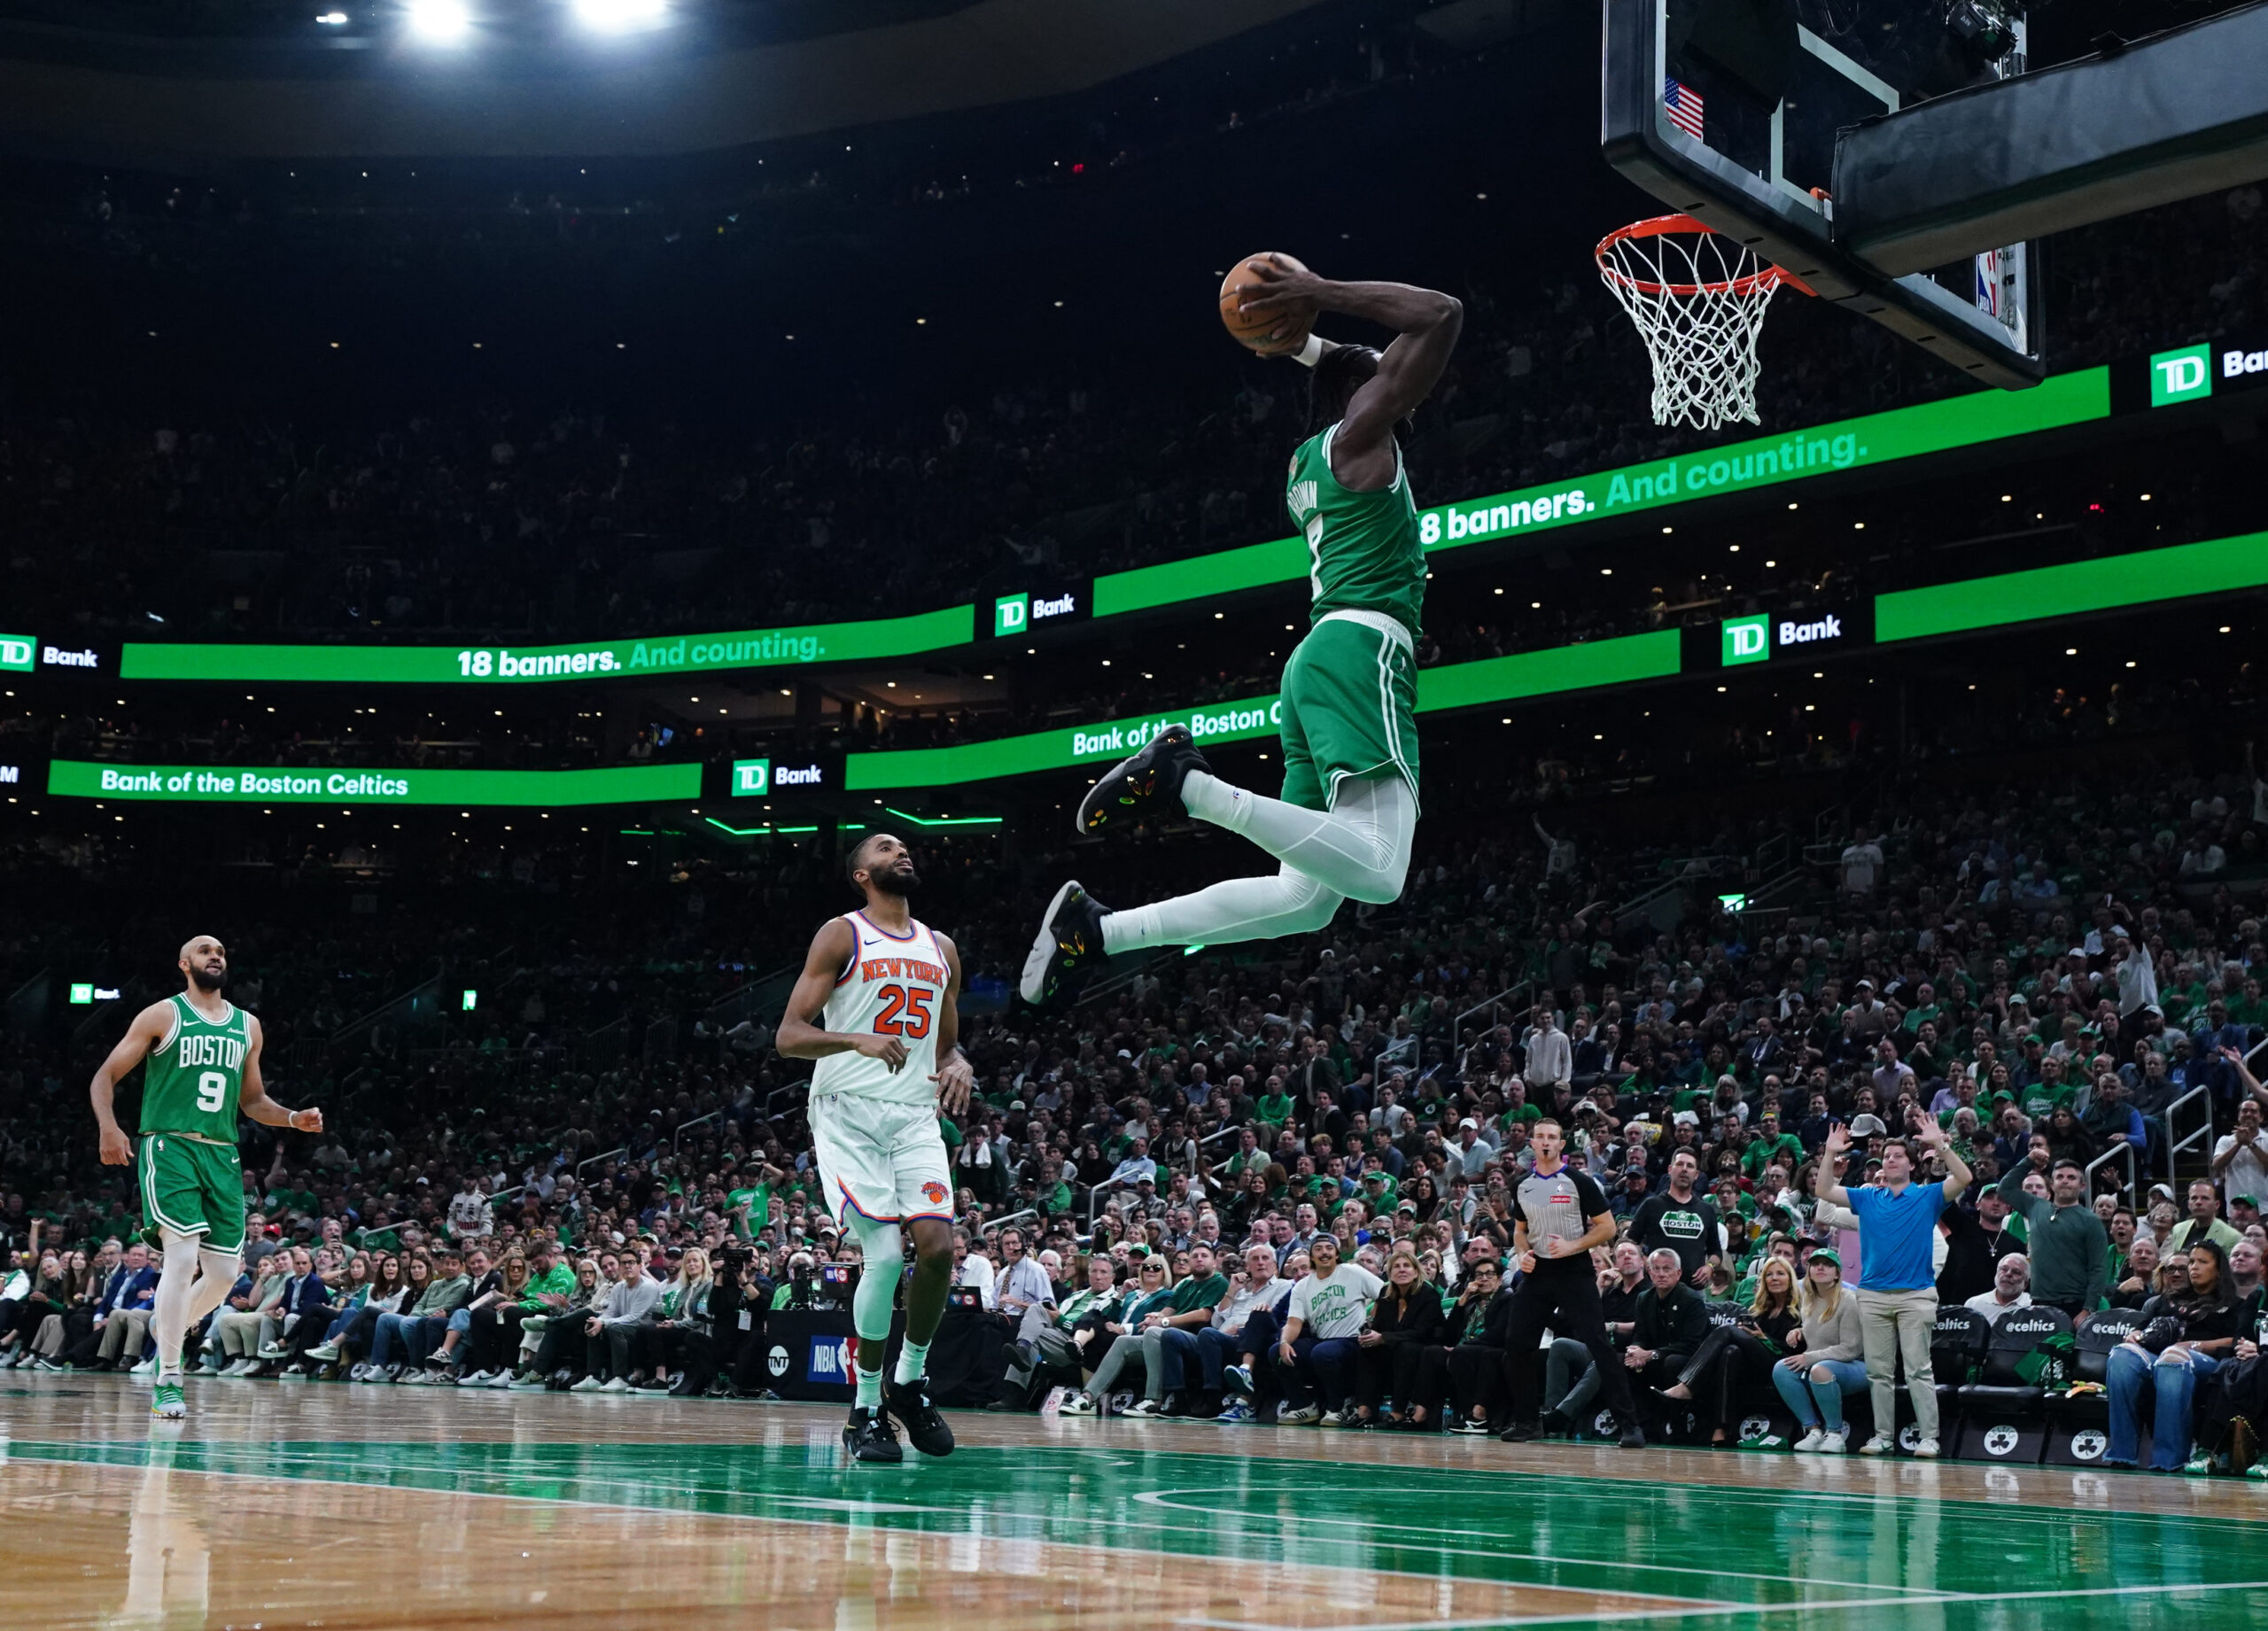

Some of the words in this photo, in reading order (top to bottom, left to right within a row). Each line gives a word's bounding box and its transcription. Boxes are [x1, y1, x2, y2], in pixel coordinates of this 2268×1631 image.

[2156, 356, 2205, 393] TD
[2223, 350, 2268, 377] Ba
[1420, 513, 1441, 545] 8
[1448, 490, 1595, 540] banners.
[1605, 461, 1677, 508] And
[1687, 431, 1868, 493] counting.
[999, 602, 1025, 627] TD
[1034, 594, 1074, 618] Bank
[1727, 623, 1765, 656] TD
[1780, 615, 1841, 645] Bank
[43, 646, 98, 668] Bank
[458, 651, 493, 677] 18
[499, 650, 621, 676] banners.
[630, 640, 686, 668] And
[691, 633, 826, 663] counting.
[1073, 726, 1122, 756] Bank
[1127, 722, 1149, 748] of
[1191, 709, 1265, 738] Boston
[101, 770, 161, 791] Bank
[167, 772, 192, 792] of
[197, 773, 235, 793] the
[240, 773, 322, 794] Boston
[327, 773, 408, 796] Celtics
[736, 765, 766, 789] TD
[775, 764, 821, 785] Bank
[861, 959, 901, 982] NEW
[903, 959, 944, 990] YORK
[873, 983, 934, 1040] 25
[179, 1035, 245, 1074] BOSTON
[196, 1070, 227, 1113] 9
[1709, 1313, 1736, 1325] eltics
[1931, 1317, 1970, 1331] celtics
[2006, 1319, 2055, 1332] @celtics
[813, 1345, 837, 1373] NBA
